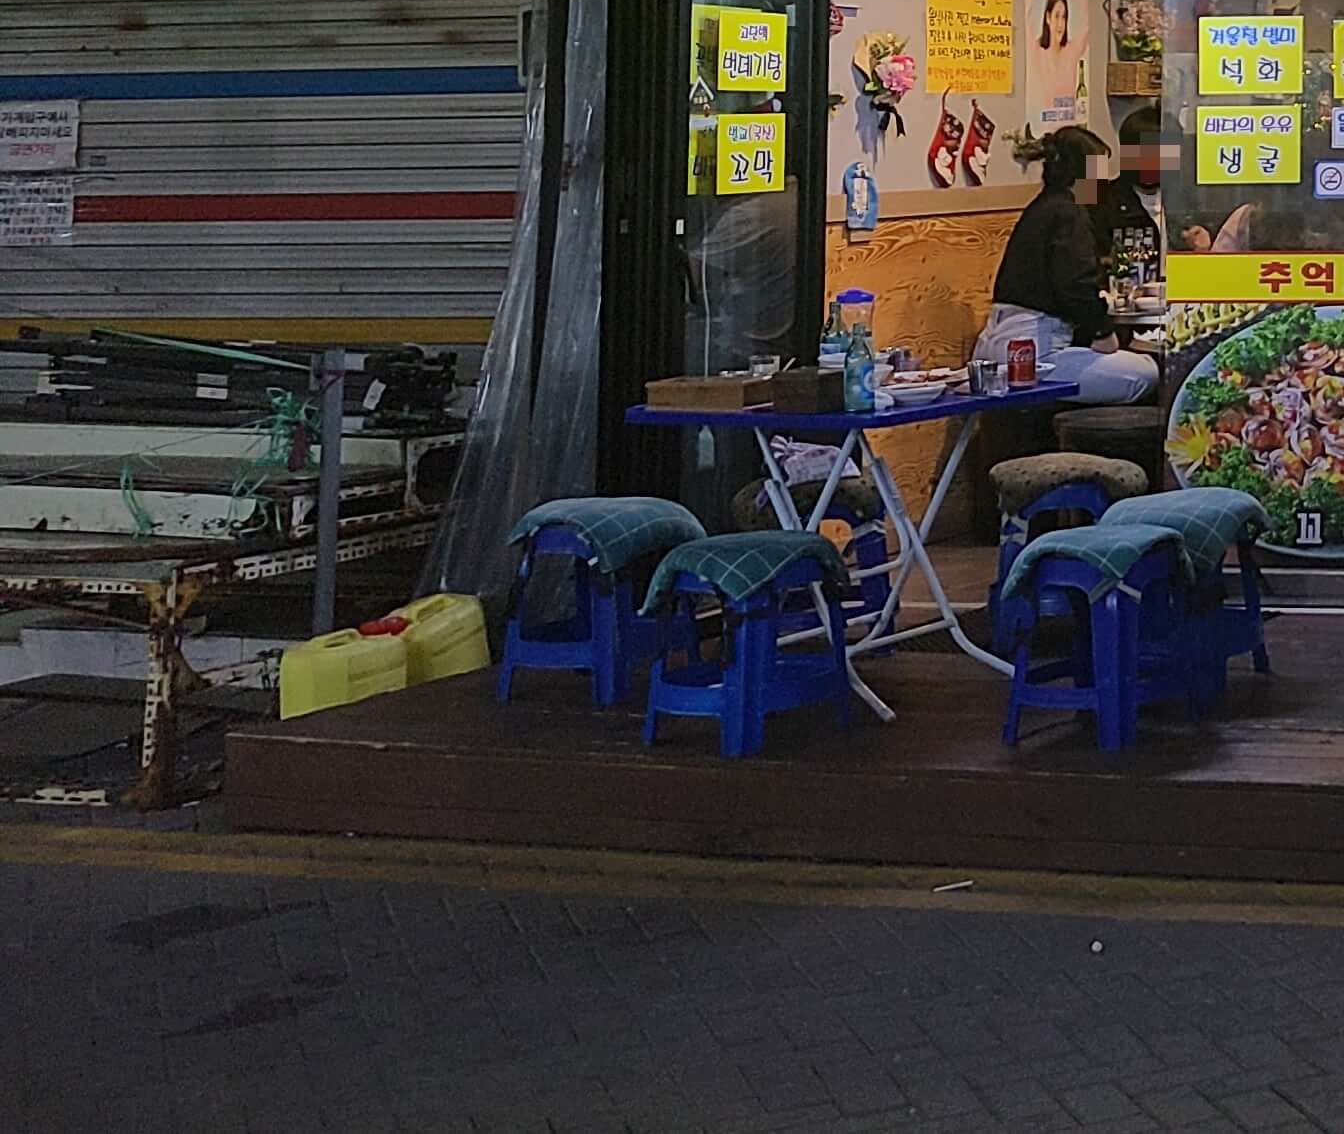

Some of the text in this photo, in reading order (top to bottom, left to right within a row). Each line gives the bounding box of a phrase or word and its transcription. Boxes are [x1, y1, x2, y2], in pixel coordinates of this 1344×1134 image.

[1262, 27, 1296, 45] 별미
[722, 51, 782, 81] 번데기탕
[1204, 116, 1293, 133] 바다의 우유
[730, 149, 774, 184] 꼬막
